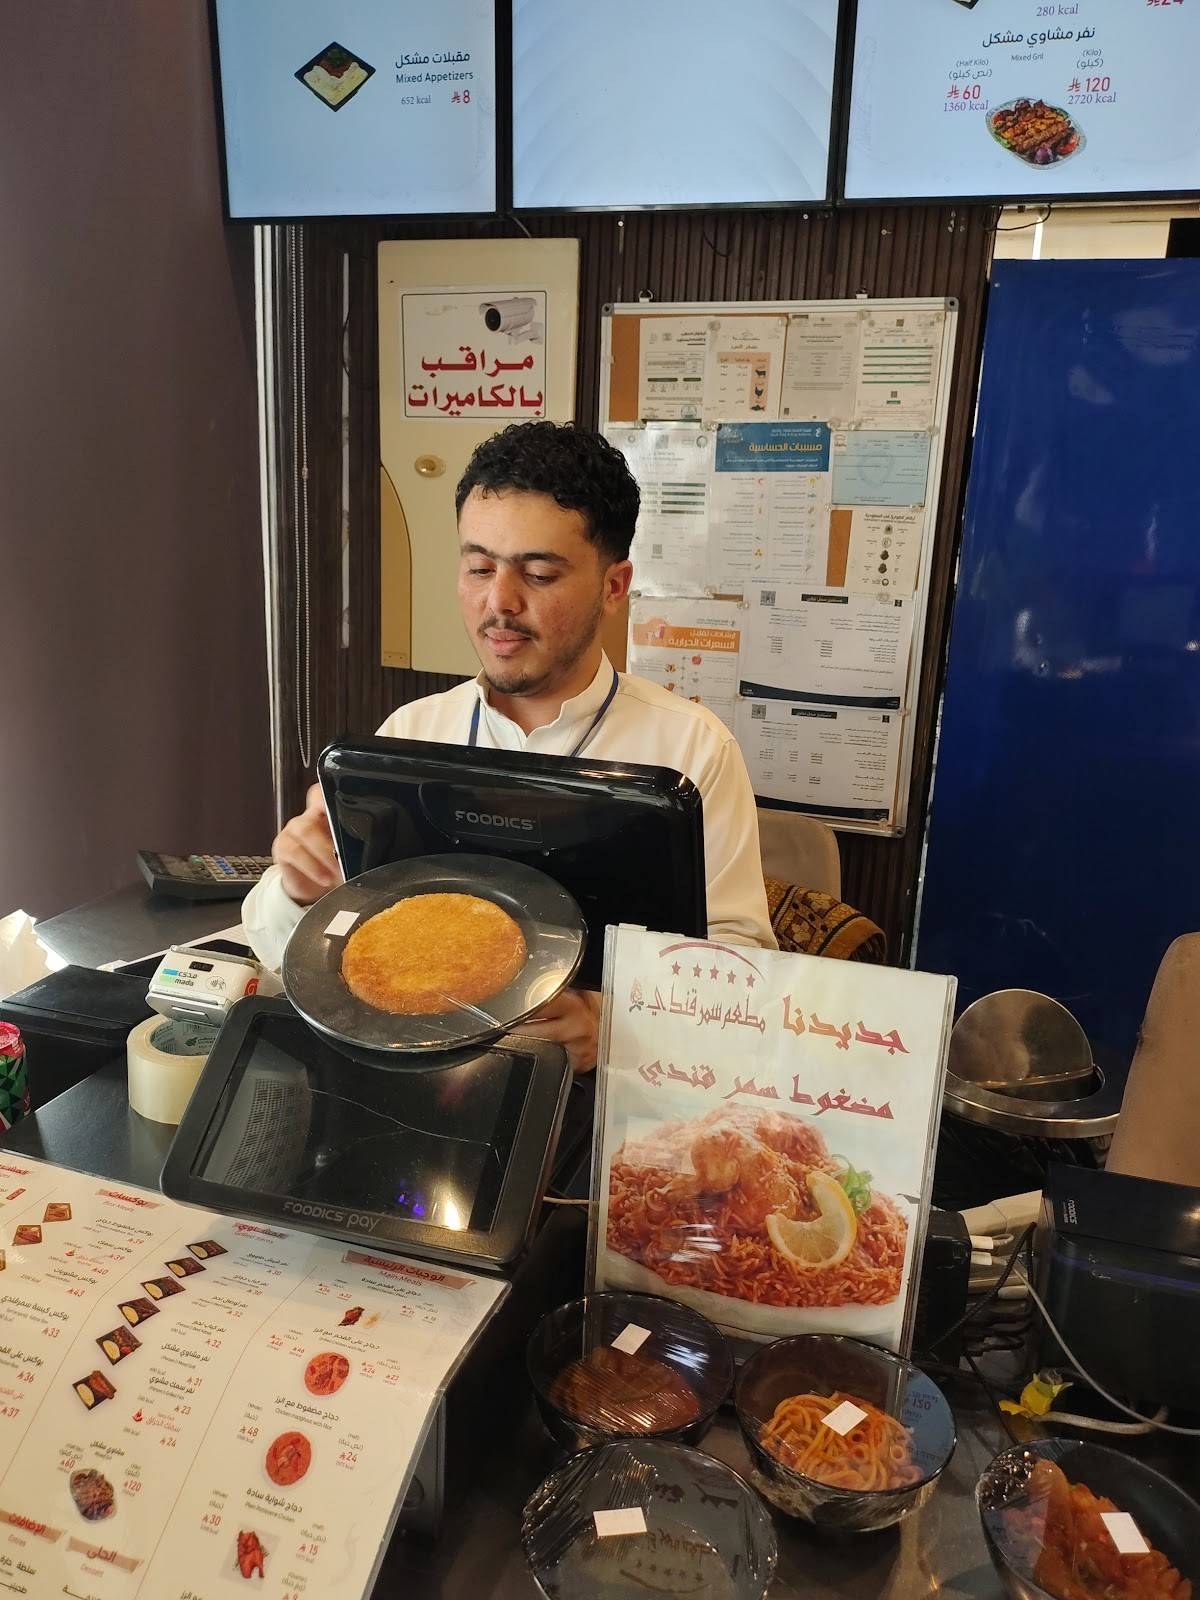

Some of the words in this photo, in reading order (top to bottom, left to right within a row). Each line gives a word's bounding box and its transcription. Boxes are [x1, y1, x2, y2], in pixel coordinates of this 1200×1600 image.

[1035, 6, 1054, 17] 280
[1057, 4, 1079, 16] kcal
[982, 30, 1024, 48] مشكل
[1026, 26, 1073, 48] مشاوي
[1075, 26, 1096, 42] نفر
[431, 51, 471, 66] مقبلات
[1011, 54, 1032, 62] Mixed
[1082, 48, 1102, 57] (Kilo)
[395, 52, 430, 69] مشكل
[1076, 58, 1104, 70] (كيلو)
[396, 72, 422, 83] Mixed
[425, 71, 474, 83] Appetizers
[1085, 76, 1111, 92] 120
[463, 89, 471, 104] 8
[962, 84, 981, 99] 60
[416, 95, 431, 104] kcal
[1068, 94, 1095, 105] 2720
[1096, 92, 1117, 104] kcal
[944, 101, 966, 112] 1360
[968, 100, 989, 111] kcal
[421, 345, 534, 378] مراقب
[408, 383, 543, 416] بالكاميرات
[700, 640, 735, 650] السعرات
[454, 809, 535, 831] FOODICS
[174, 978, 195, 987] mada
[721, 991, 766, 1035] مطعم
[782, 994, 911, 1055] جديدنا
[788, 1073, 894, 1120] مضغوط
[107, 1190, 149, 1207] بوكسات
[282, 1200, 344, 1223] FOODICS
[346, 1213, 381, 1233] pay
[1068, 1199, 1078, 1225] FOODICS
[362, 1254, 406, 1273] الرئيسية
[378, 1270, 399, 1282] Main
[405, 1266, 447, 1282] الوجبات
[48, 1310, 70, 1321] بوكس
[48, 1327, 61, 1338] 33
[160, 1342, 180, 1353] مشكل
[179, 1348, 202, 1360] مشاوي
[22, 1356, 44, 1367] بوكس
[199, 1354, 211, 1363] نفر
[148, 1375, 170, 1386] مشوي
[169, 1380, 186, 1392] سمك
[184, 1386, 196, 1395] نفر
[274, 1395, 286, 1405] الرز
[284, 1399, 296, 1408] مع
[7, 1406, 20, 1419] 37
[180, 1404, 192, 1416] 23
[321, 1411, 340, 1422] دجاج
[247, 1425, 260, 1438] 48
[166, 1436, 178, 1448] 24
[346, 1450, 358, 1464] 24
[128, 1479, 142, 1493] 120
[246, 1486, 266, 1500] سادة
[284, 1502, 304, 1514] دجاج
[209, 1513, 222, 1528] 30
[86, 1545, 118, 1563] الحلى
[308, 1542, 320, 1557] 15
